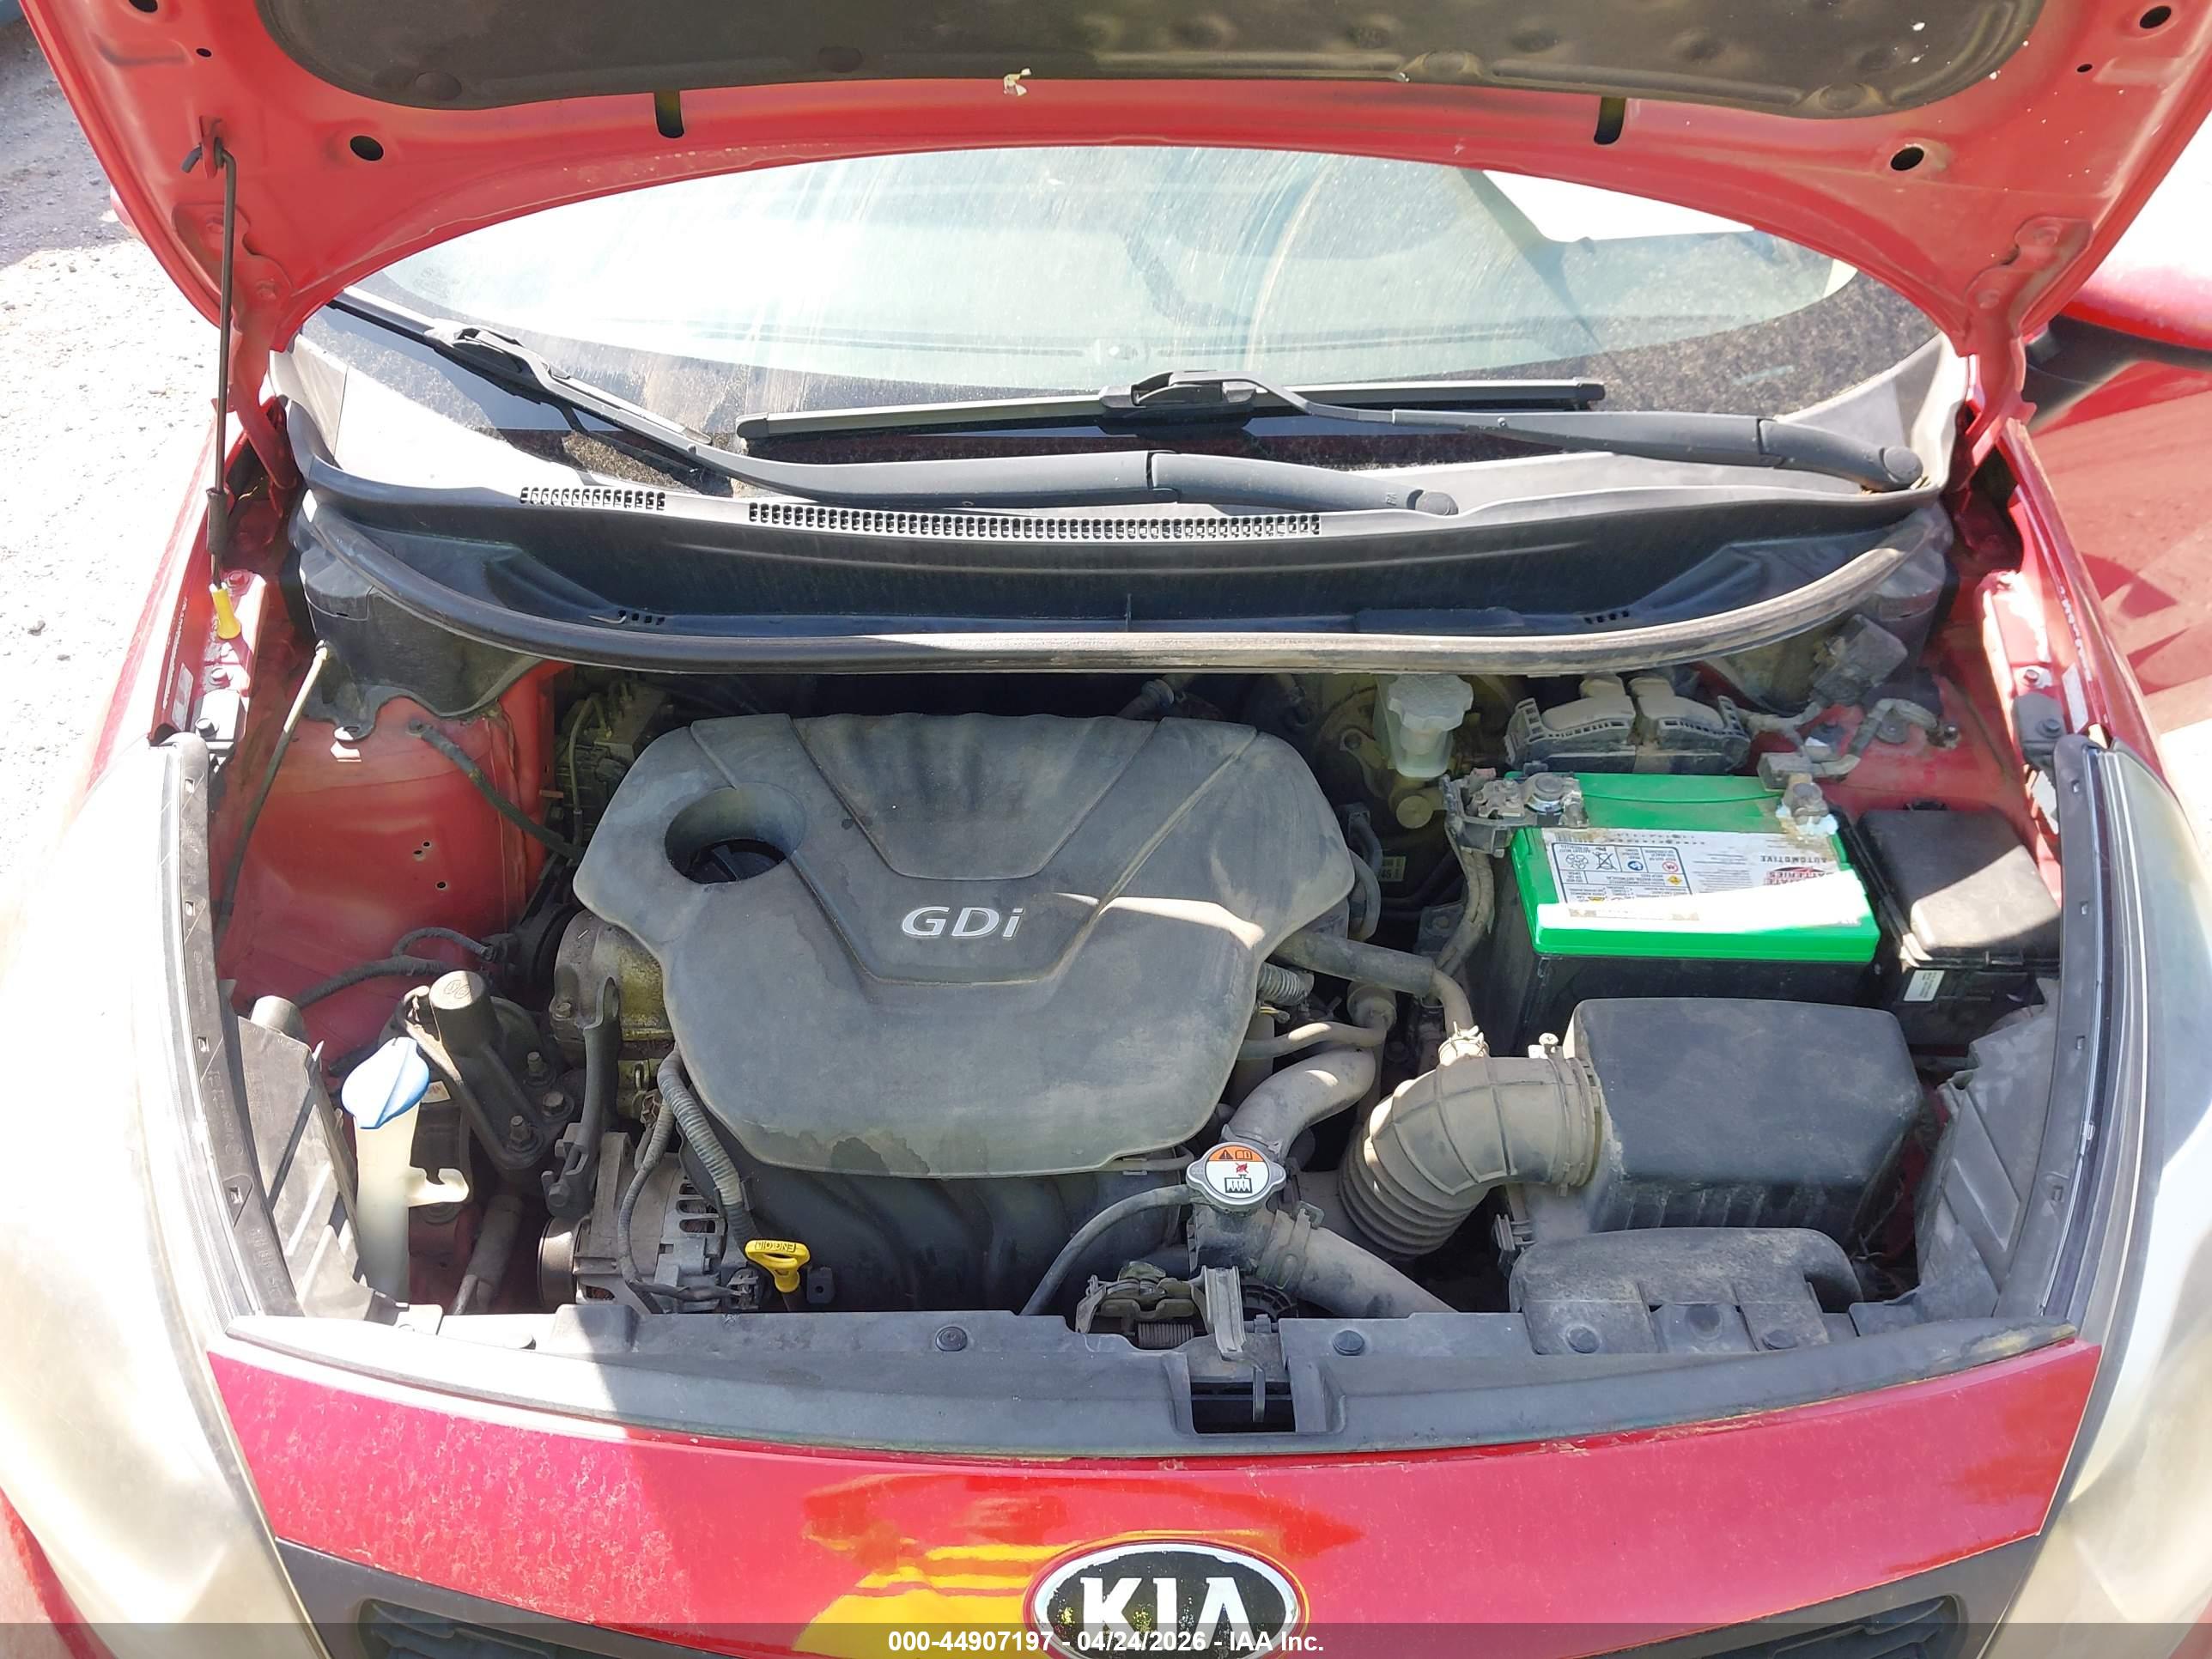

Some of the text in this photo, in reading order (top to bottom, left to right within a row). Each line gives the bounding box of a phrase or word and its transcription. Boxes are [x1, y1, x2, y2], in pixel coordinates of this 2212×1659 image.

[1760, 855, 1827, 864] AUTOMOTIVE
[902, 906, 1024, 939] GDi
[755, 1240, 797, 1253] ENG OIL
[1080, 1577, 1256, 1650] KIA
